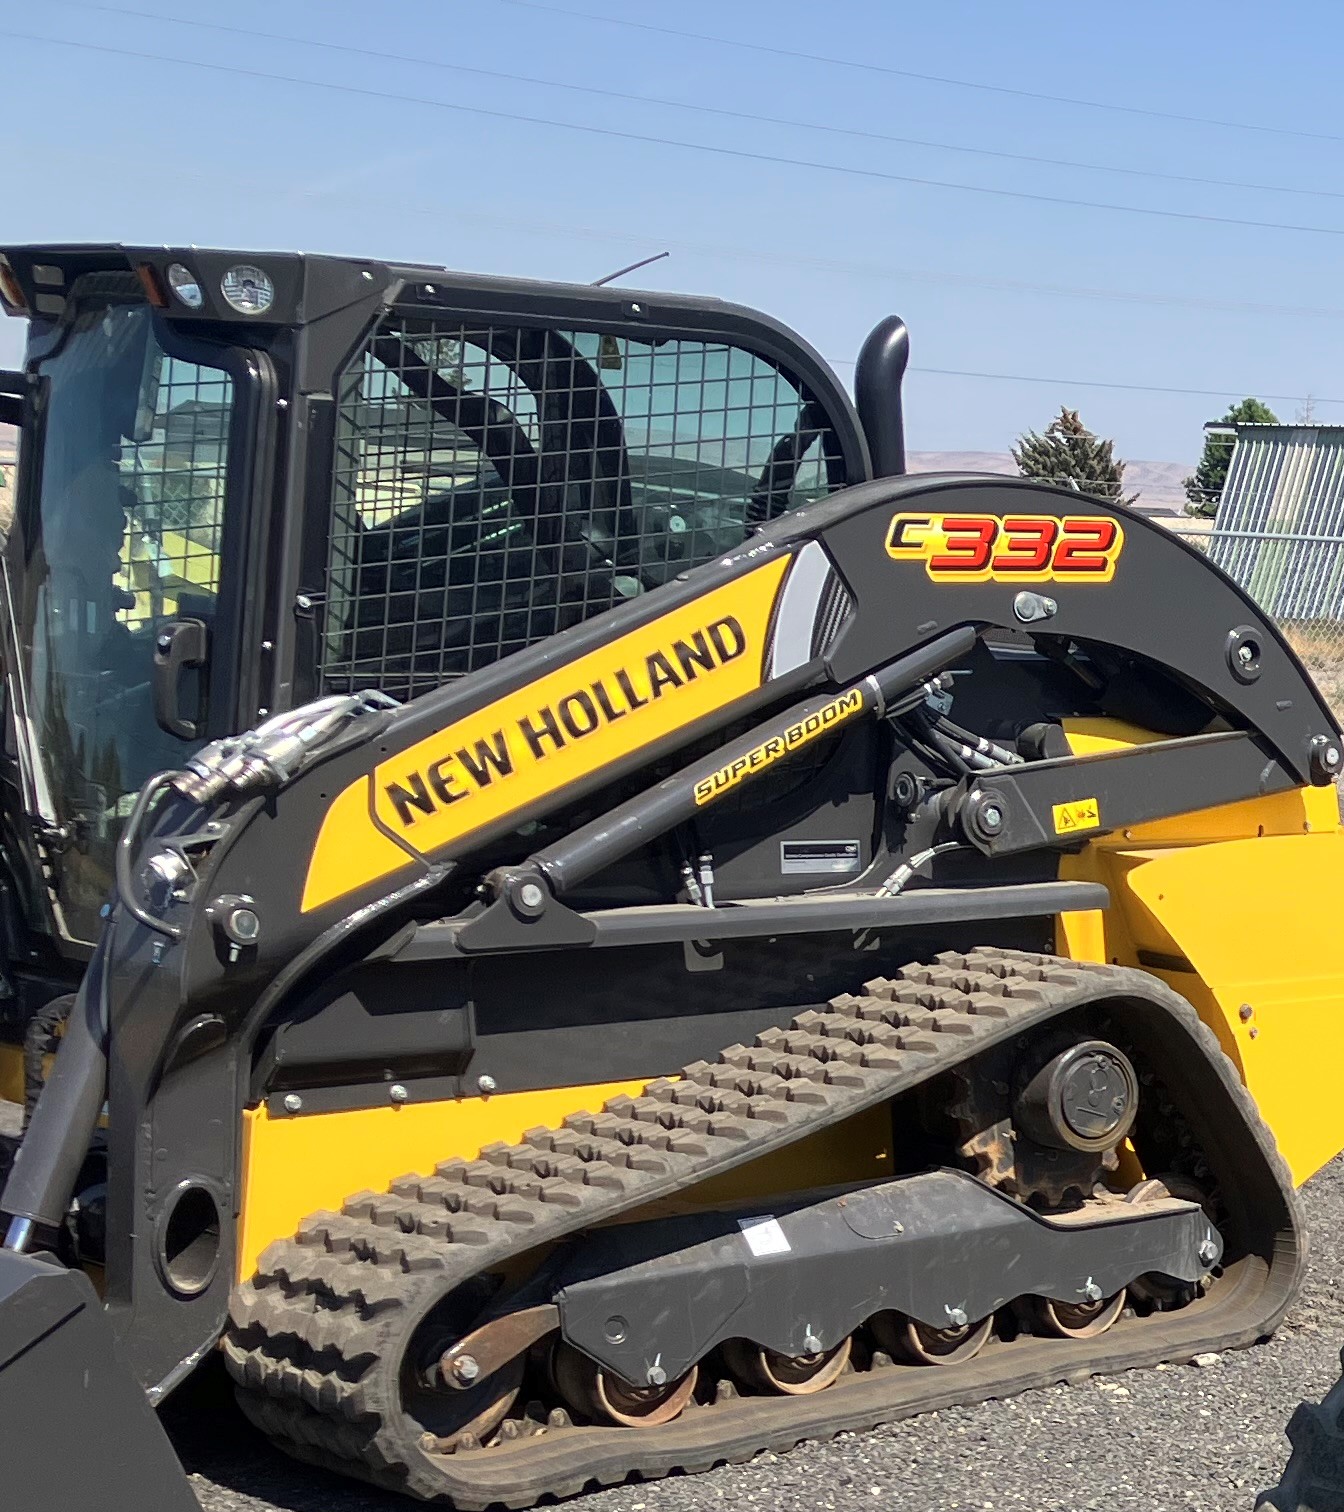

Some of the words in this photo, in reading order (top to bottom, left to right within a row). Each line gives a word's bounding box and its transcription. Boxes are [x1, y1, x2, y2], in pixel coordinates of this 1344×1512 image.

[889, 517, 1117, 572] C332
[384, 728, 515, 828] NEW
[517, 614, 747, 760] HOLLAND
[697, 739, 780, 801] SUPER
[787, 691, 858, 744] BOOM
